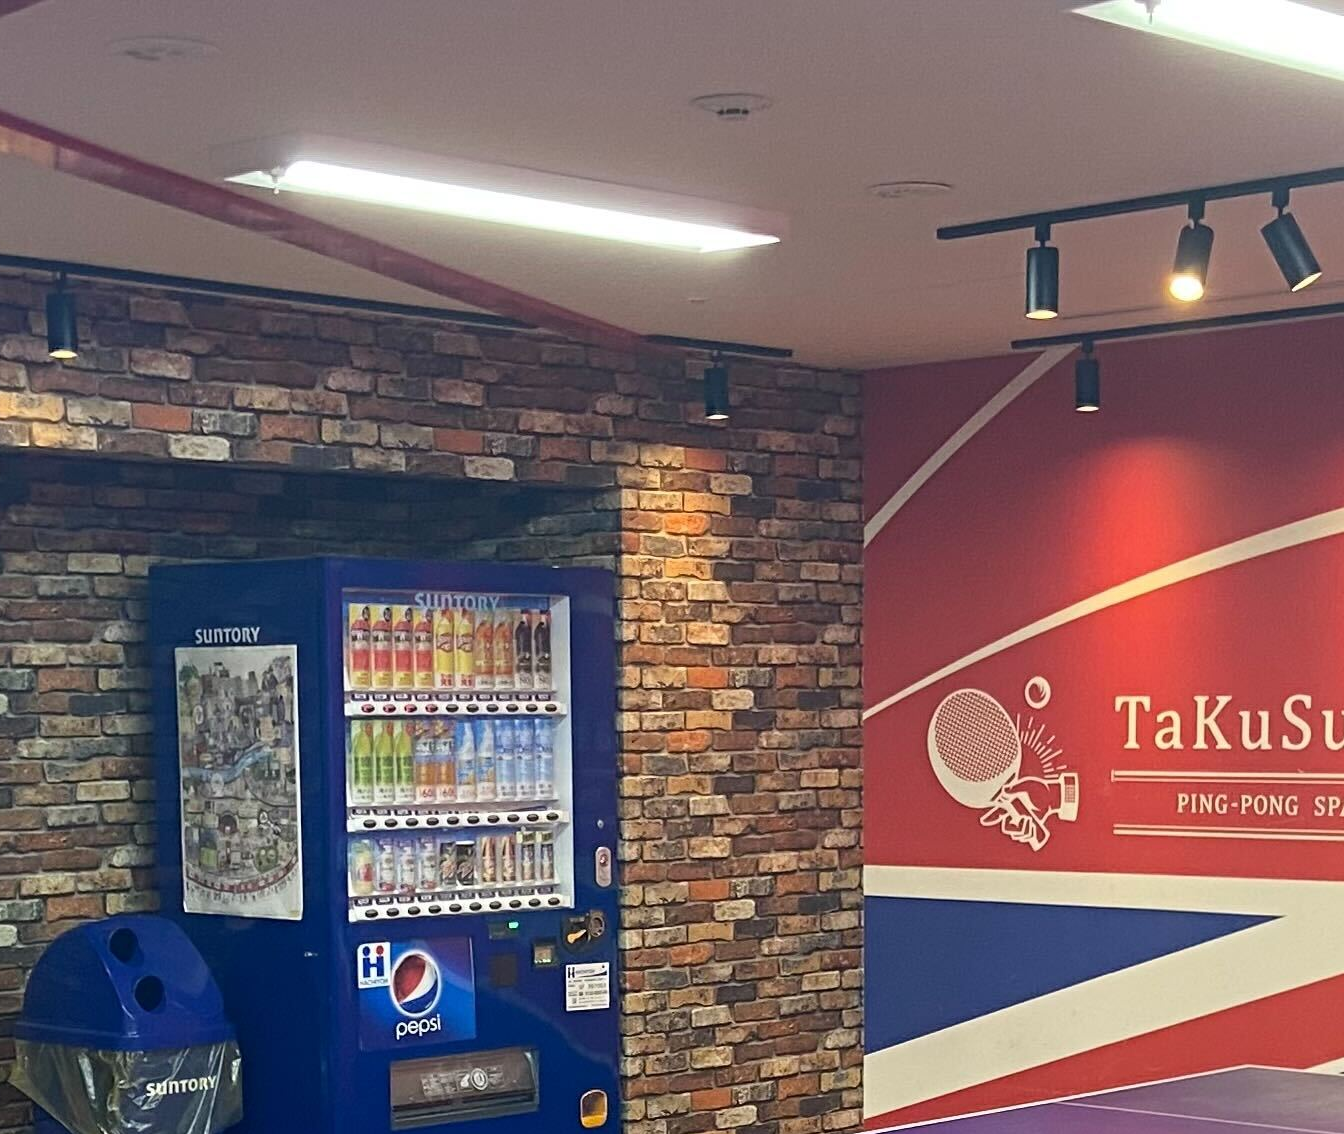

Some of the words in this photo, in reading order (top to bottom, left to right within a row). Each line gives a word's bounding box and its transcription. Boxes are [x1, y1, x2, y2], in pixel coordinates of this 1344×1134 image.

[195, 626, 260, 645] SUNTORY
[1176, 793, 1299, 818] PING-PONG
[396, 1013, 442, 1041] pepsi
[146, 1075, 217, 1097] SUNTORY
